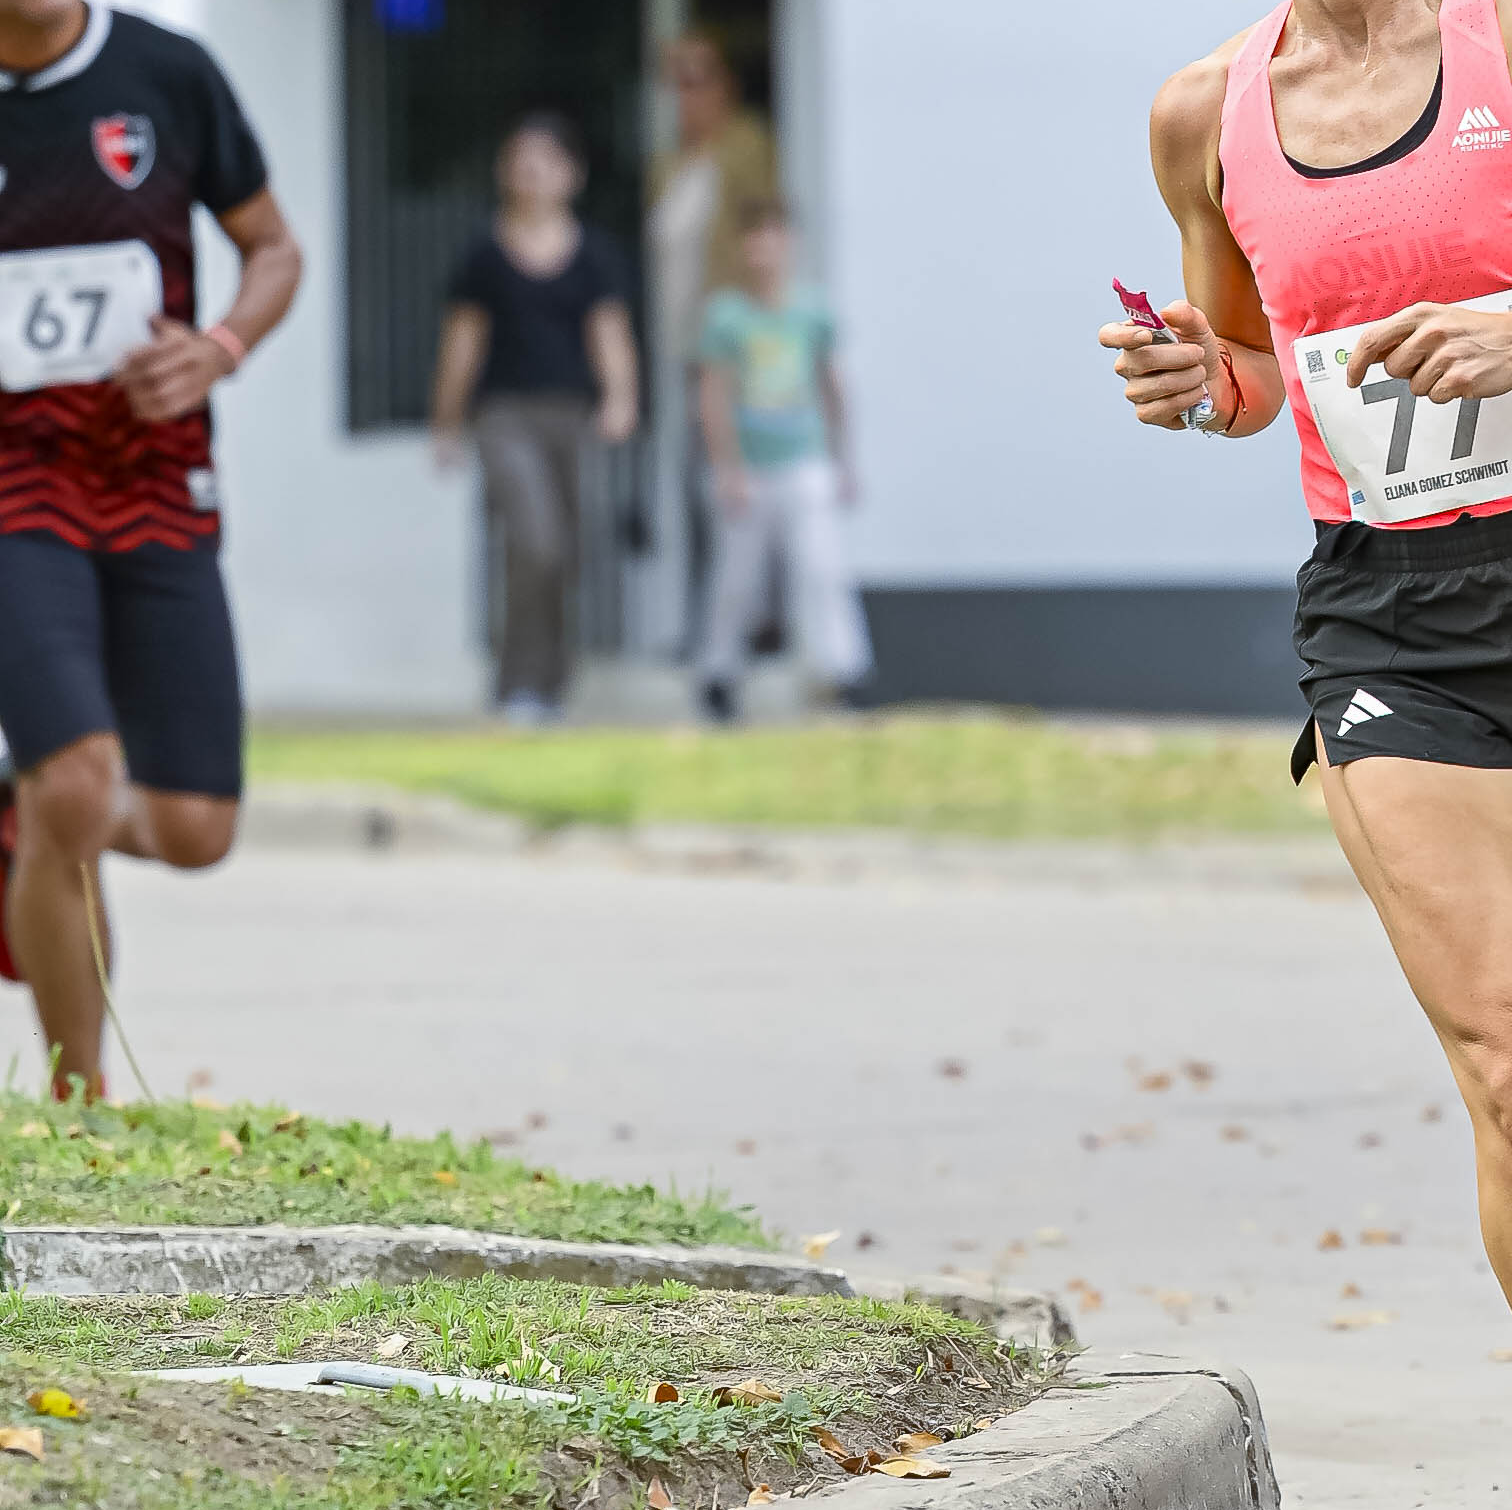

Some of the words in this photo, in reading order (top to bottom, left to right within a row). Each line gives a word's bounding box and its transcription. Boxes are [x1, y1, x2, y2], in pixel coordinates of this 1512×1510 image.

[1451, 129, 1511, 148] AONIJIE
[24, 288, 106, 349] 67
[1384, 481, 1418, 501] ELIANA
[1418, 472, 1454, 493] GOMEZ
[1454, 459, 1509, 485] SCHWINDT
